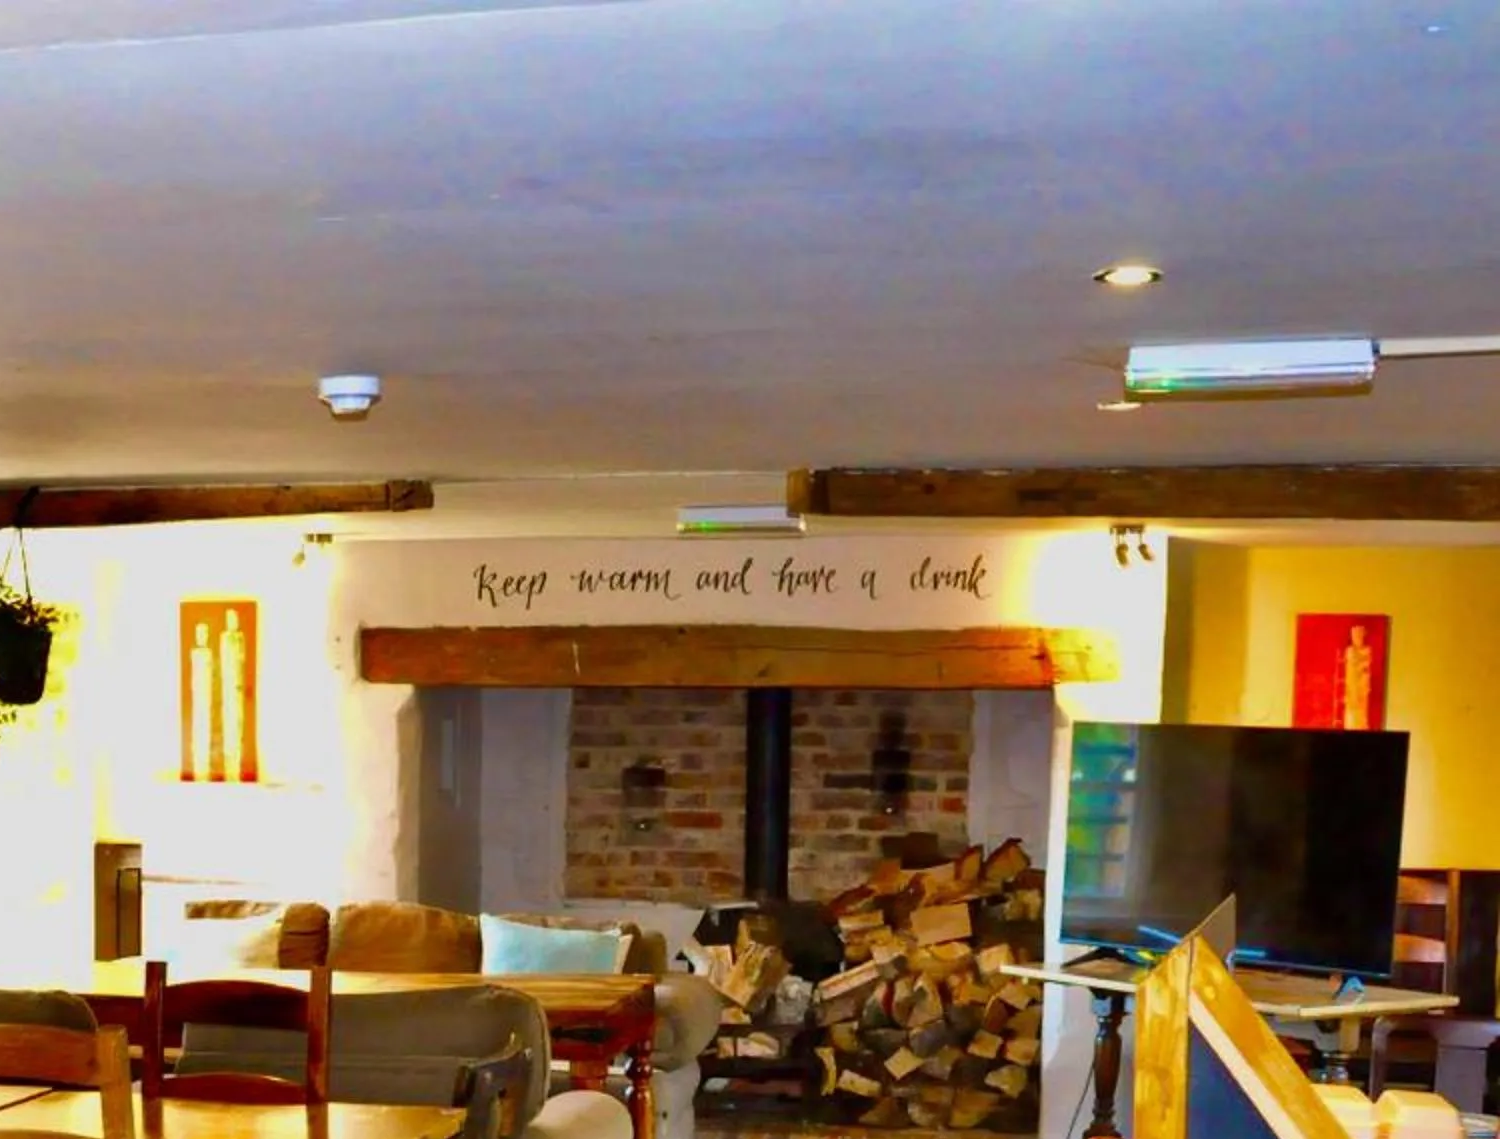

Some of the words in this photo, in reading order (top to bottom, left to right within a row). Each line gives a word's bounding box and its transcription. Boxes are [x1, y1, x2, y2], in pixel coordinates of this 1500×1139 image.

[473, 563, 547, 610] Keep
[570, 568, 682, 601] warm
[696, 557, 754, 596] and
[772, 557, 838, 597] have
[860, 569, 879, 601] a
[909, 554, 992, 600] drink
